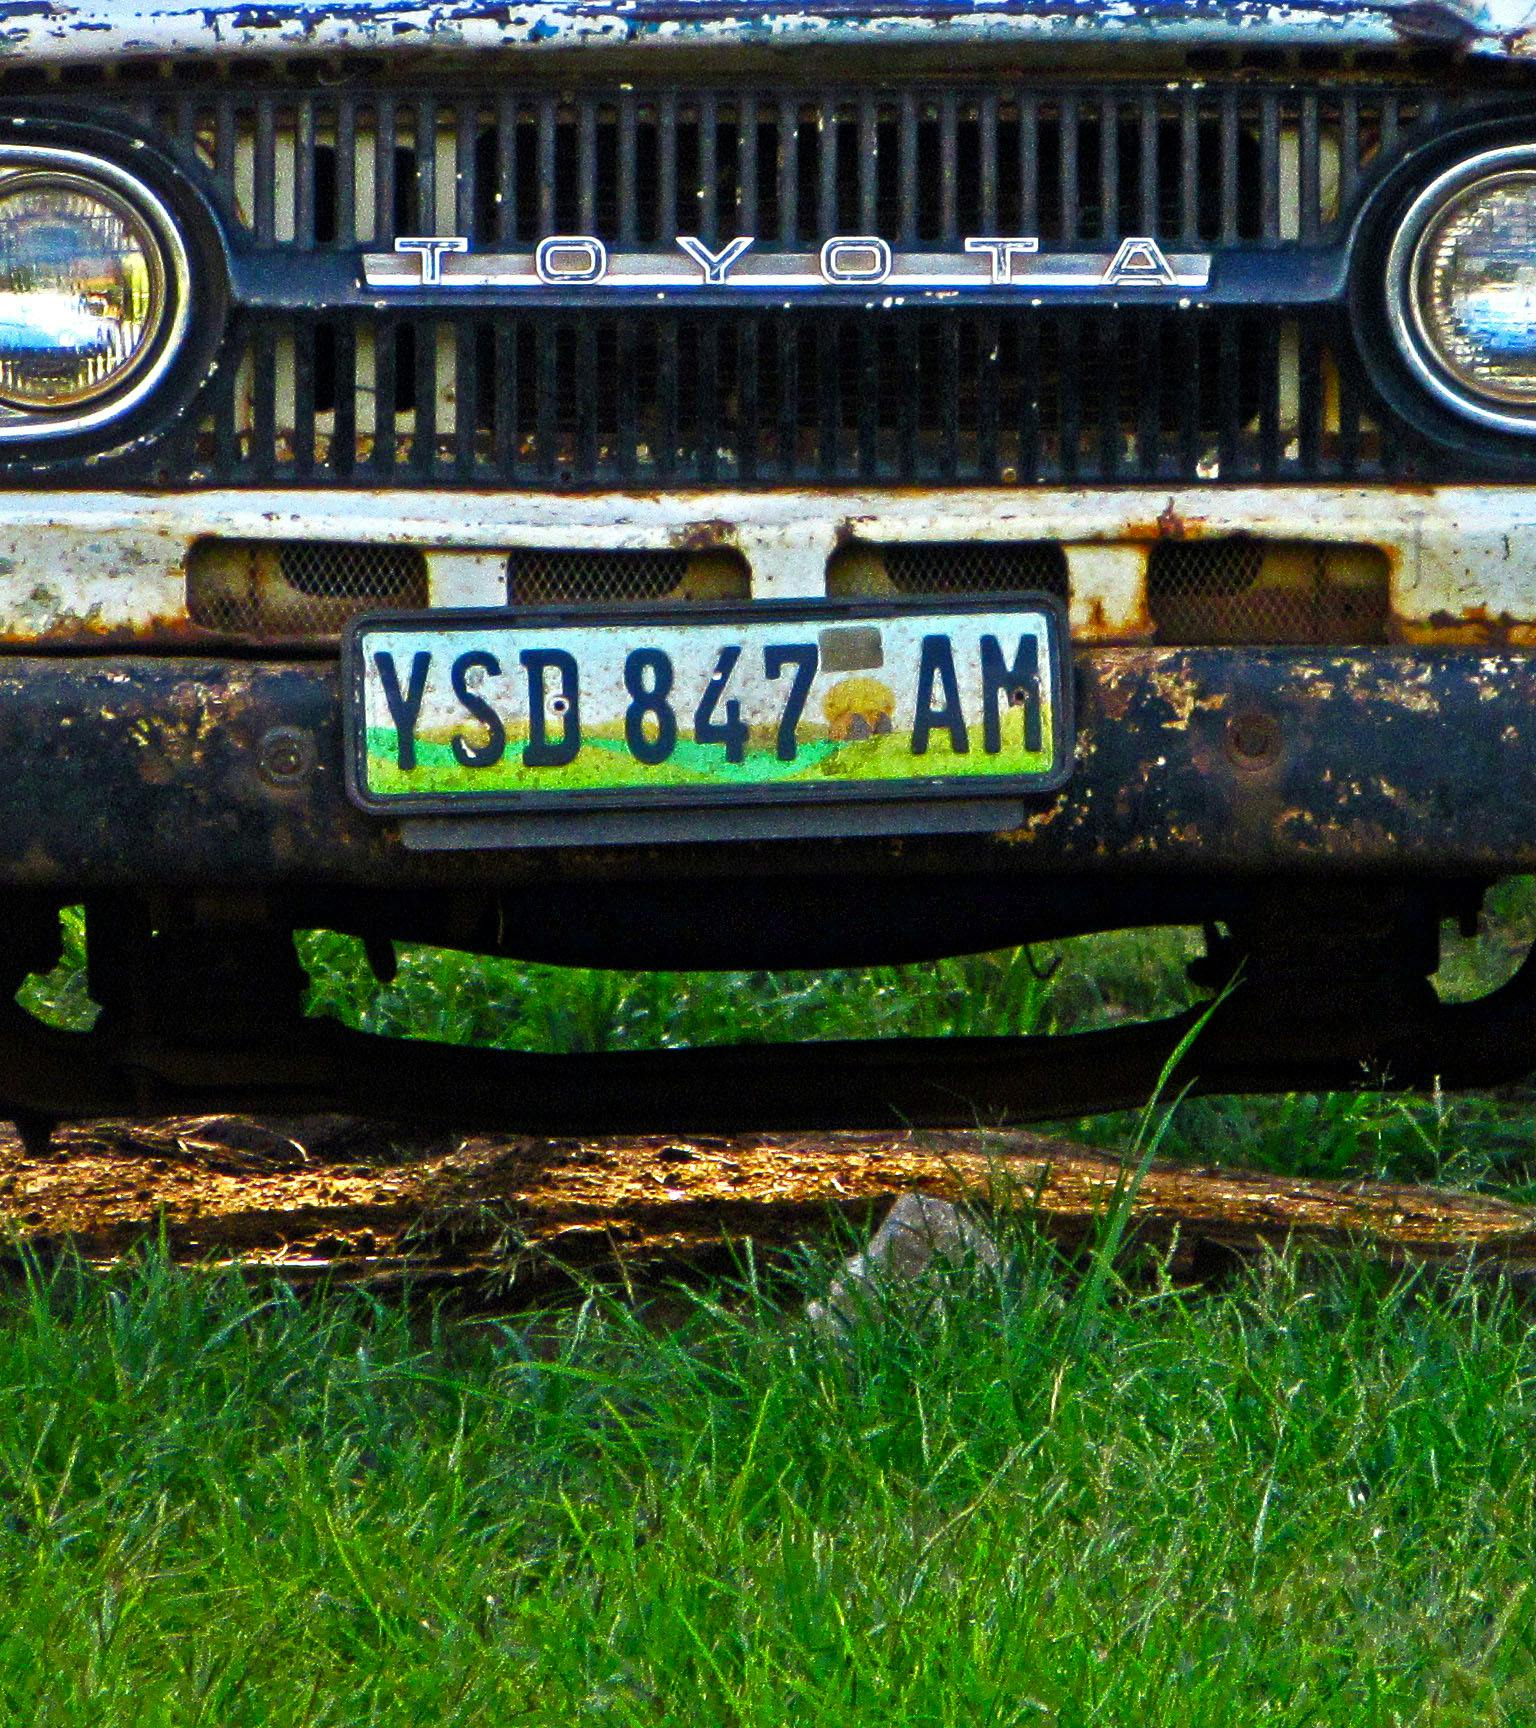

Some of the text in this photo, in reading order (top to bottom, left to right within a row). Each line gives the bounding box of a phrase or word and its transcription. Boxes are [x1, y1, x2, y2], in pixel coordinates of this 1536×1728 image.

[394, 235, 1180, 286] TOYOTA
[373, 632, 1043, 772] YSD 847 AM
